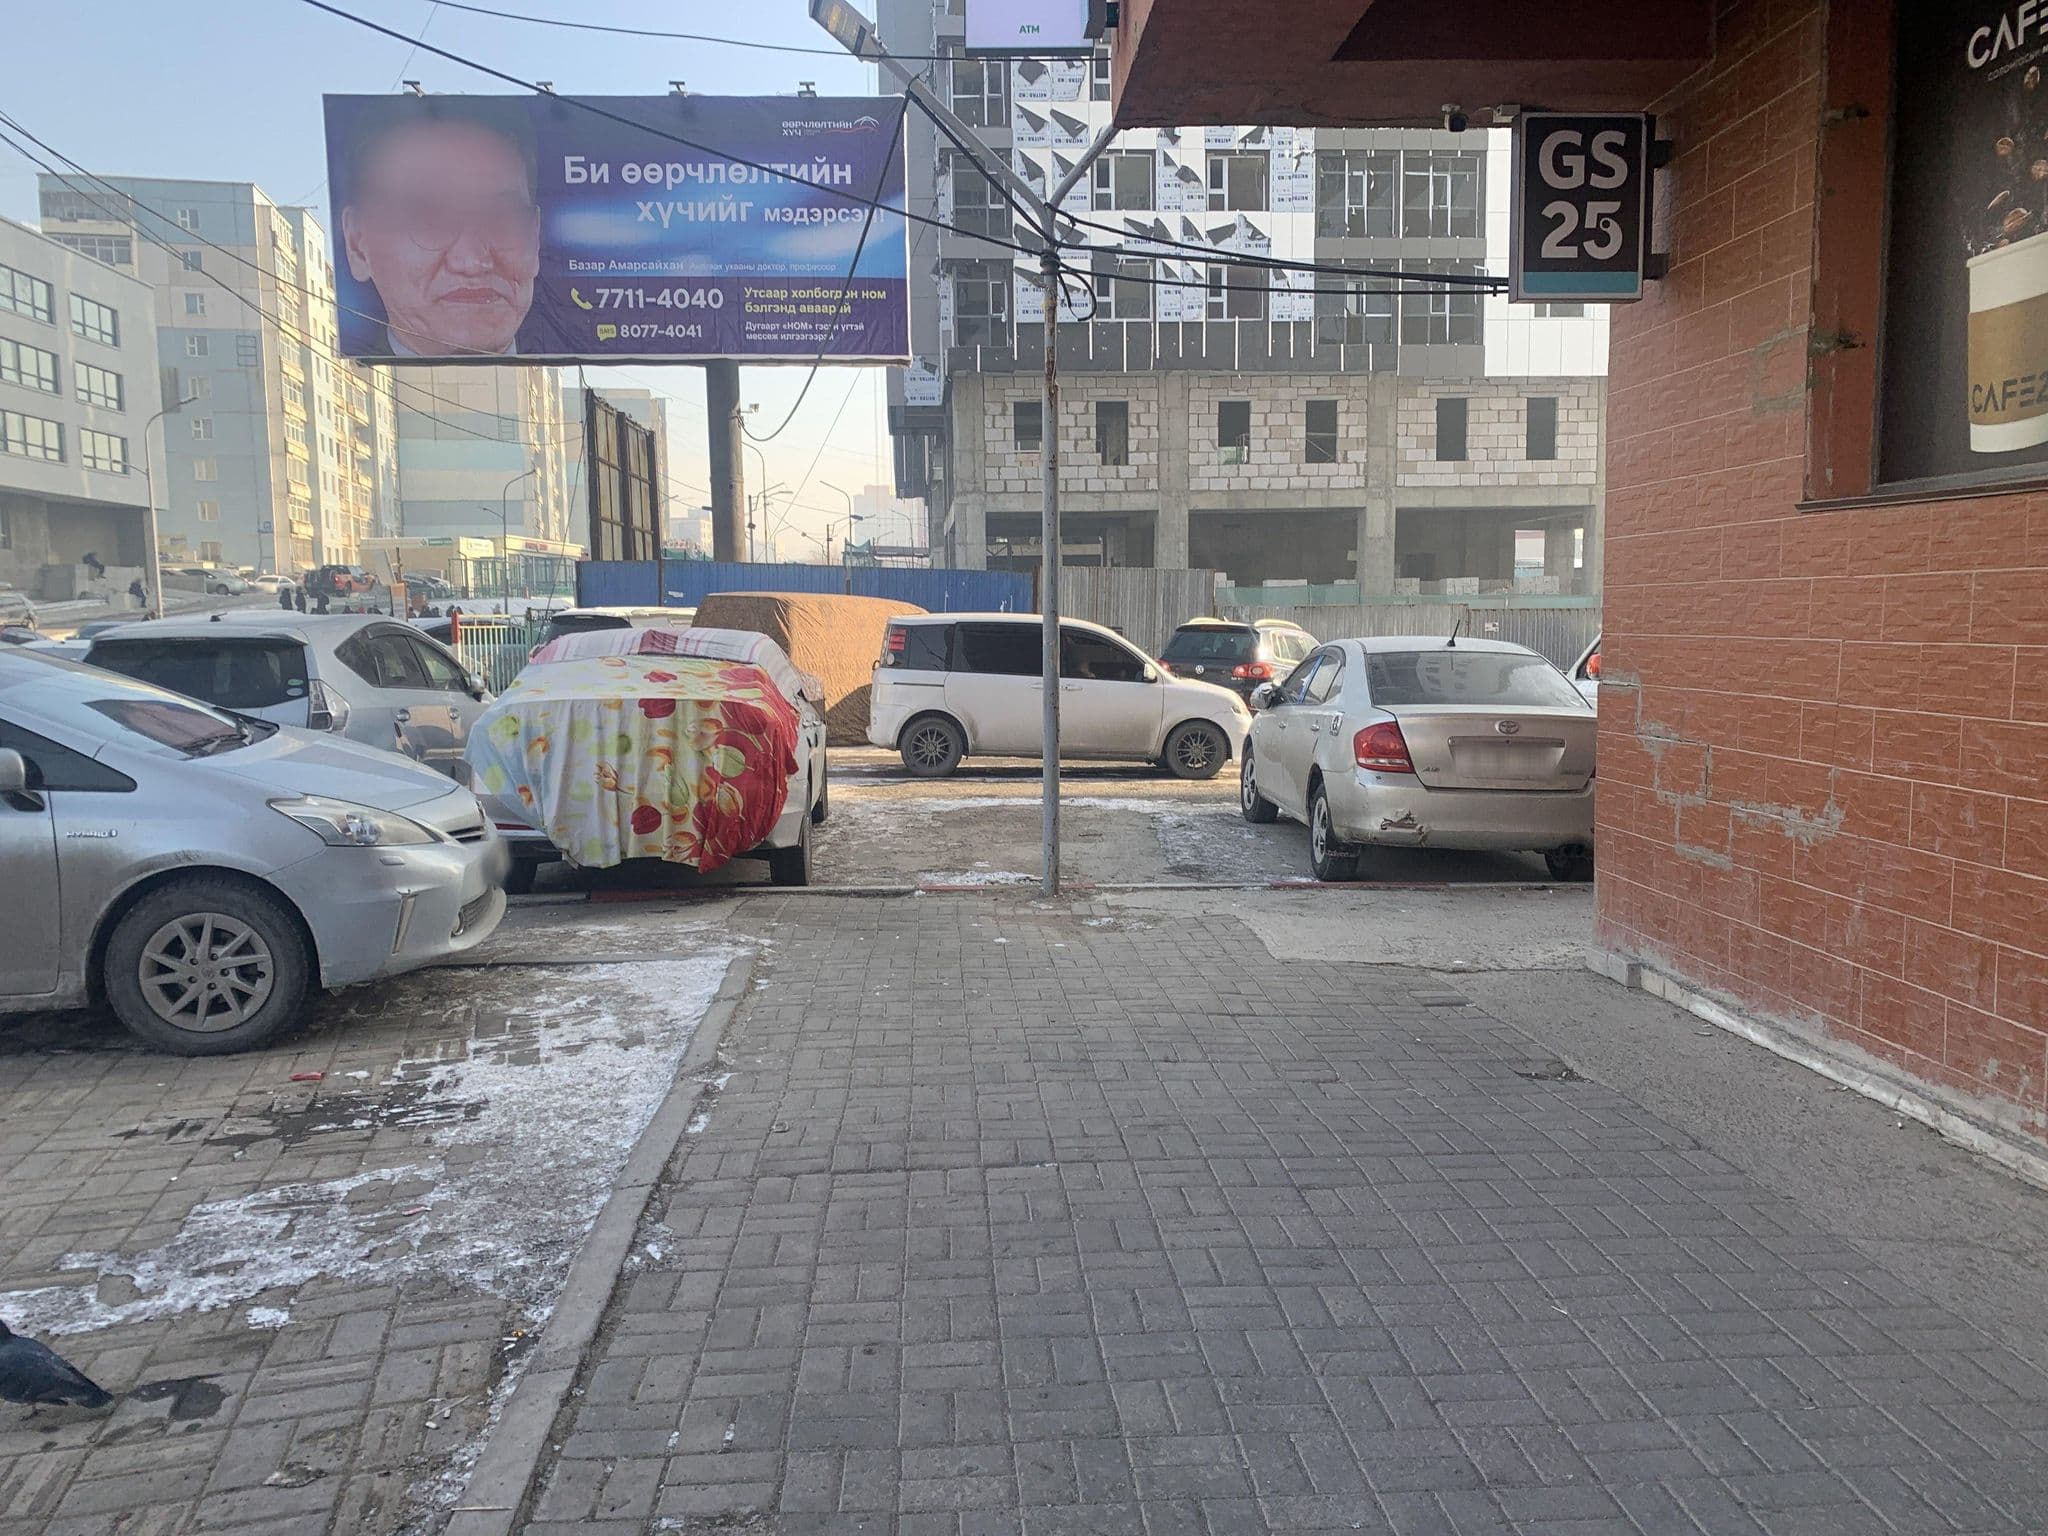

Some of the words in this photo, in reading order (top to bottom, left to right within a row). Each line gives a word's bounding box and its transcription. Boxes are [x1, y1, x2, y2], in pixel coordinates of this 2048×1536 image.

[1018, 24, 1040, 34] ATM
[782, 129, 802, 137] ХҮЧ
[1538, 129, 1629, 190] GS
[564, 155, 610, 184] Би
[621, 155, 852, 191] өөрчлөлтийн
[636, 194, 754, 229] хүчийг
[1540, 200, 1623, 260] 25
[569, 259, 606, 272] Базар
[608, 259, 684, 272] Амарсайхан
[595, 288, 724, 309] 7711-4040
[744, 287, 788, 300] Утсаар
[861, 290, 886, 299] ном
[744, 302, 796, 315] бэлгэнд
[620, 324, 702, 338] 8077-4041
[745, 321, 780, 331] Дугаарт
[746, 333, 778, 341] мессеж
